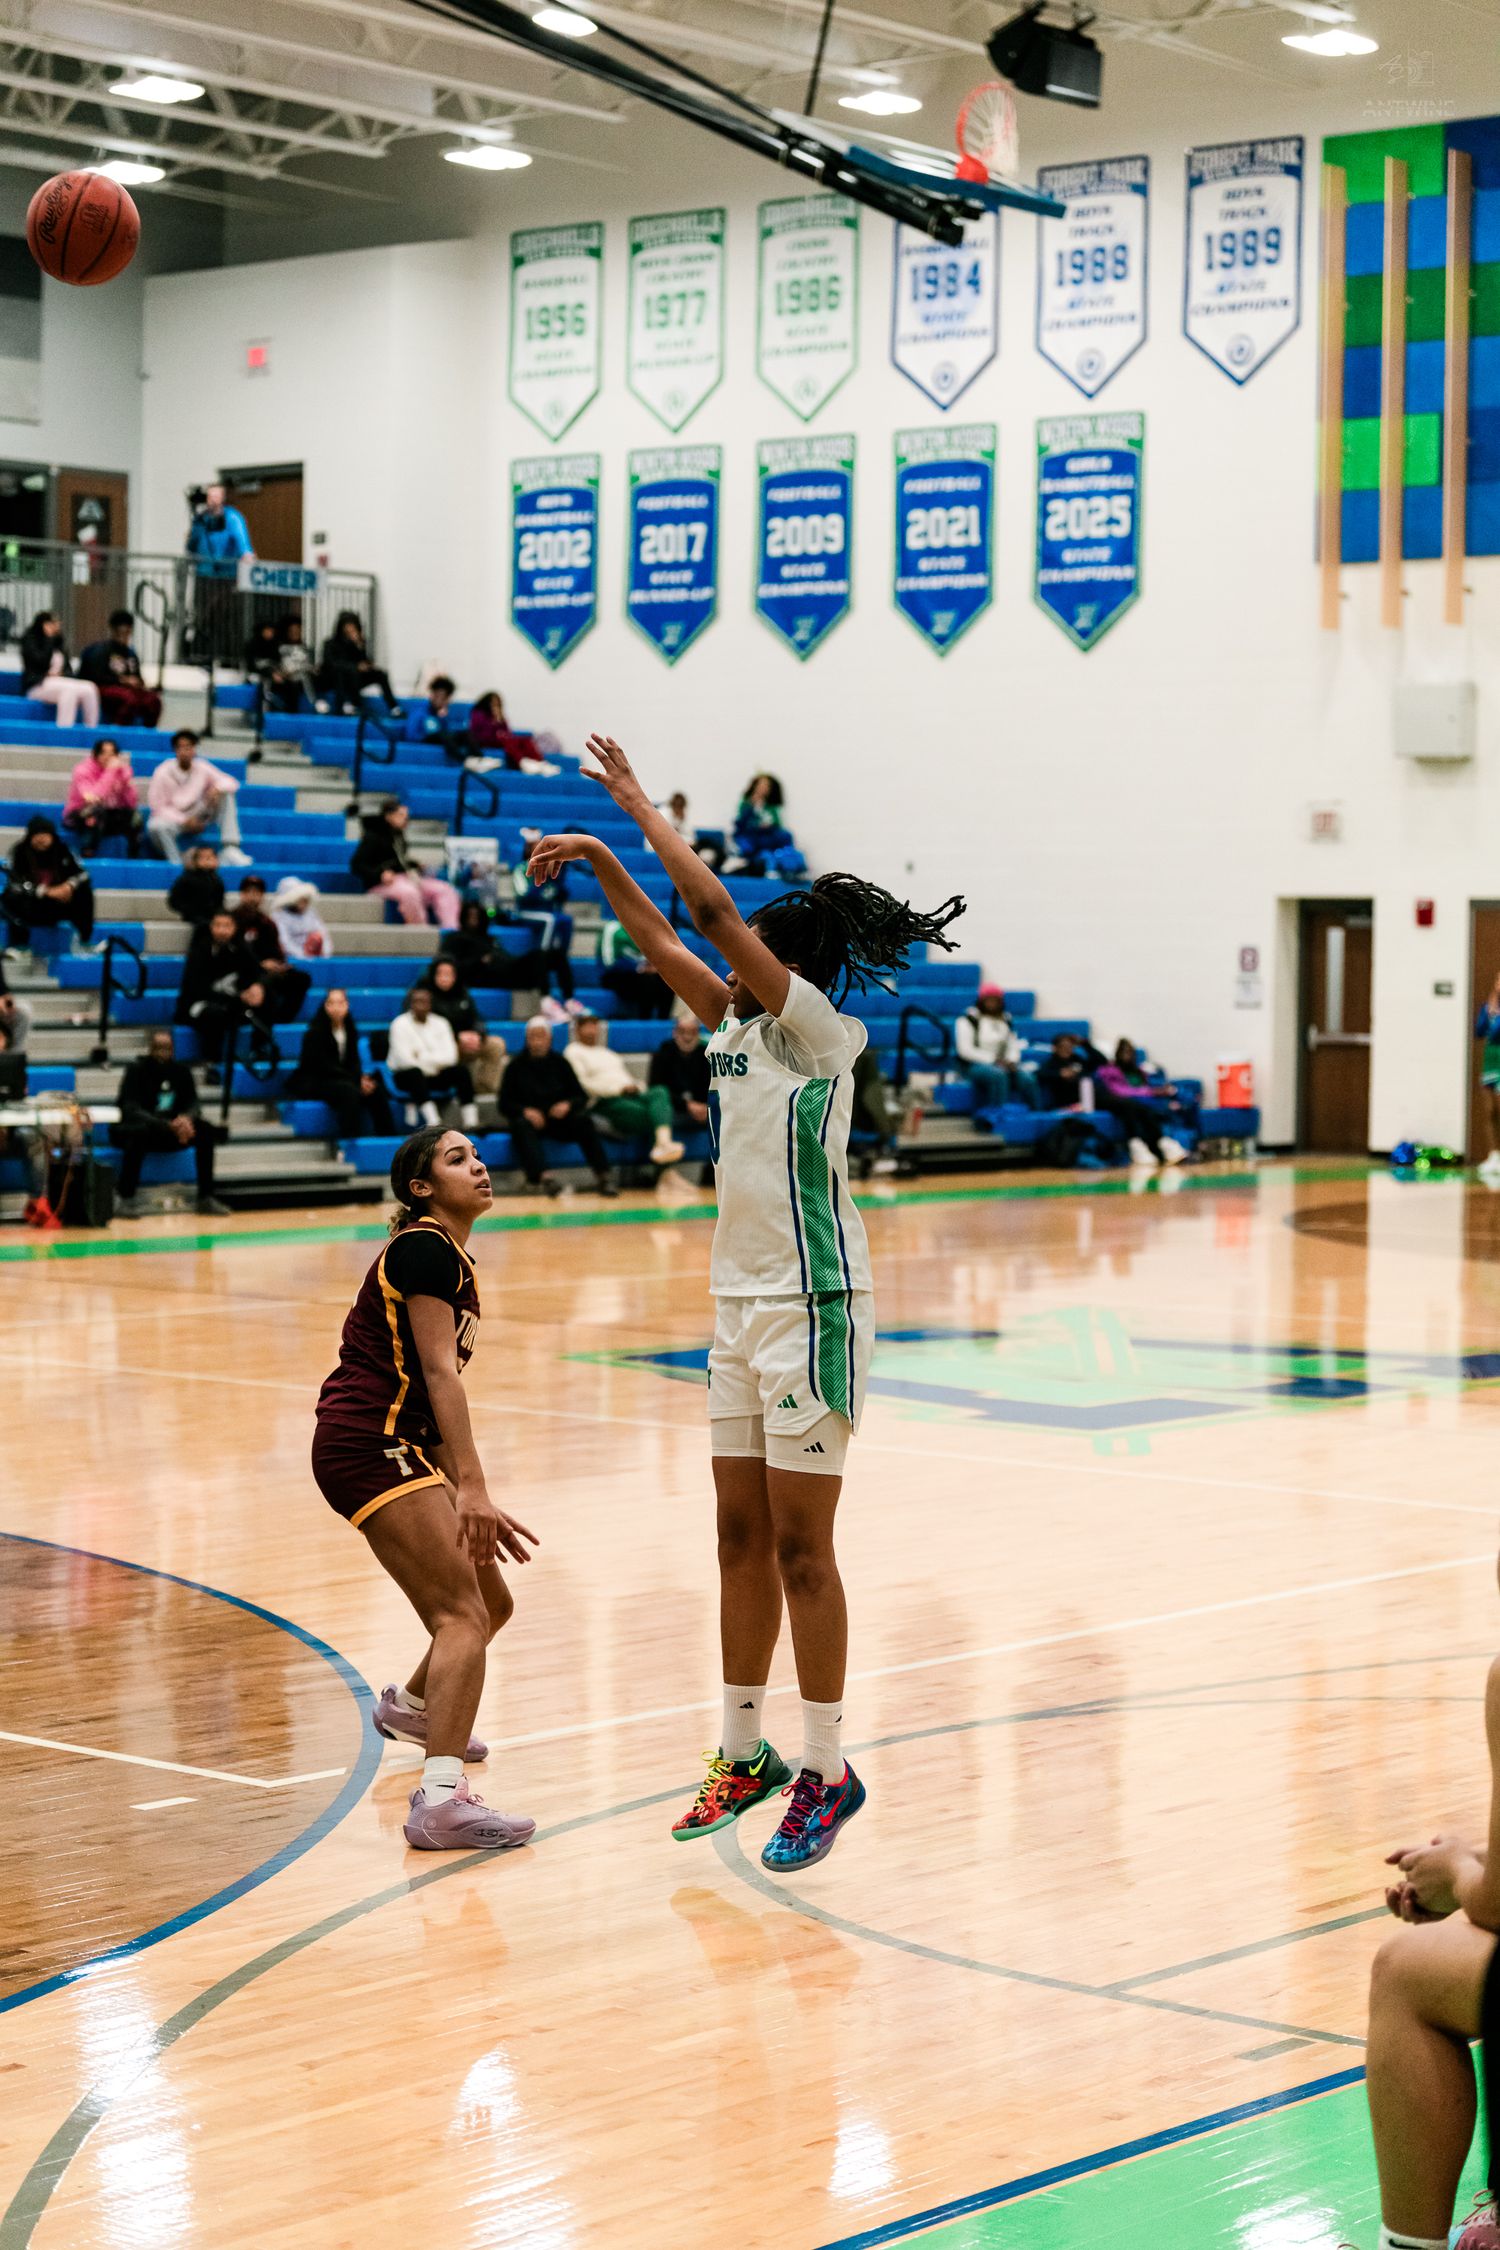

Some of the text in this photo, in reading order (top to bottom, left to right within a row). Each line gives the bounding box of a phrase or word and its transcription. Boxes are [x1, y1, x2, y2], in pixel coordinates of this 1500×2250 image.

[1056, 243, 1129, 287] 1988
[1204, 226, 1282, 272] 1989
[775, 275, 841, 316] 1986
[912, 259, 981, 302] 1984
[526, 302, 586, 341] 1956
[645, 289, 706, 330] 1977
[766, 513, 845, 558] 2009
[905, 505, 981, 551] 2021
[1045, 494, 1132, 541] 2025
[518, 528, 592, 571] 2002
[639, 521, 708, 565] 2017
[250, 566, 317, 591] CHEER
[707, 1052, 749, 1078] IORS
[383, 1444, 413, 1477] T
